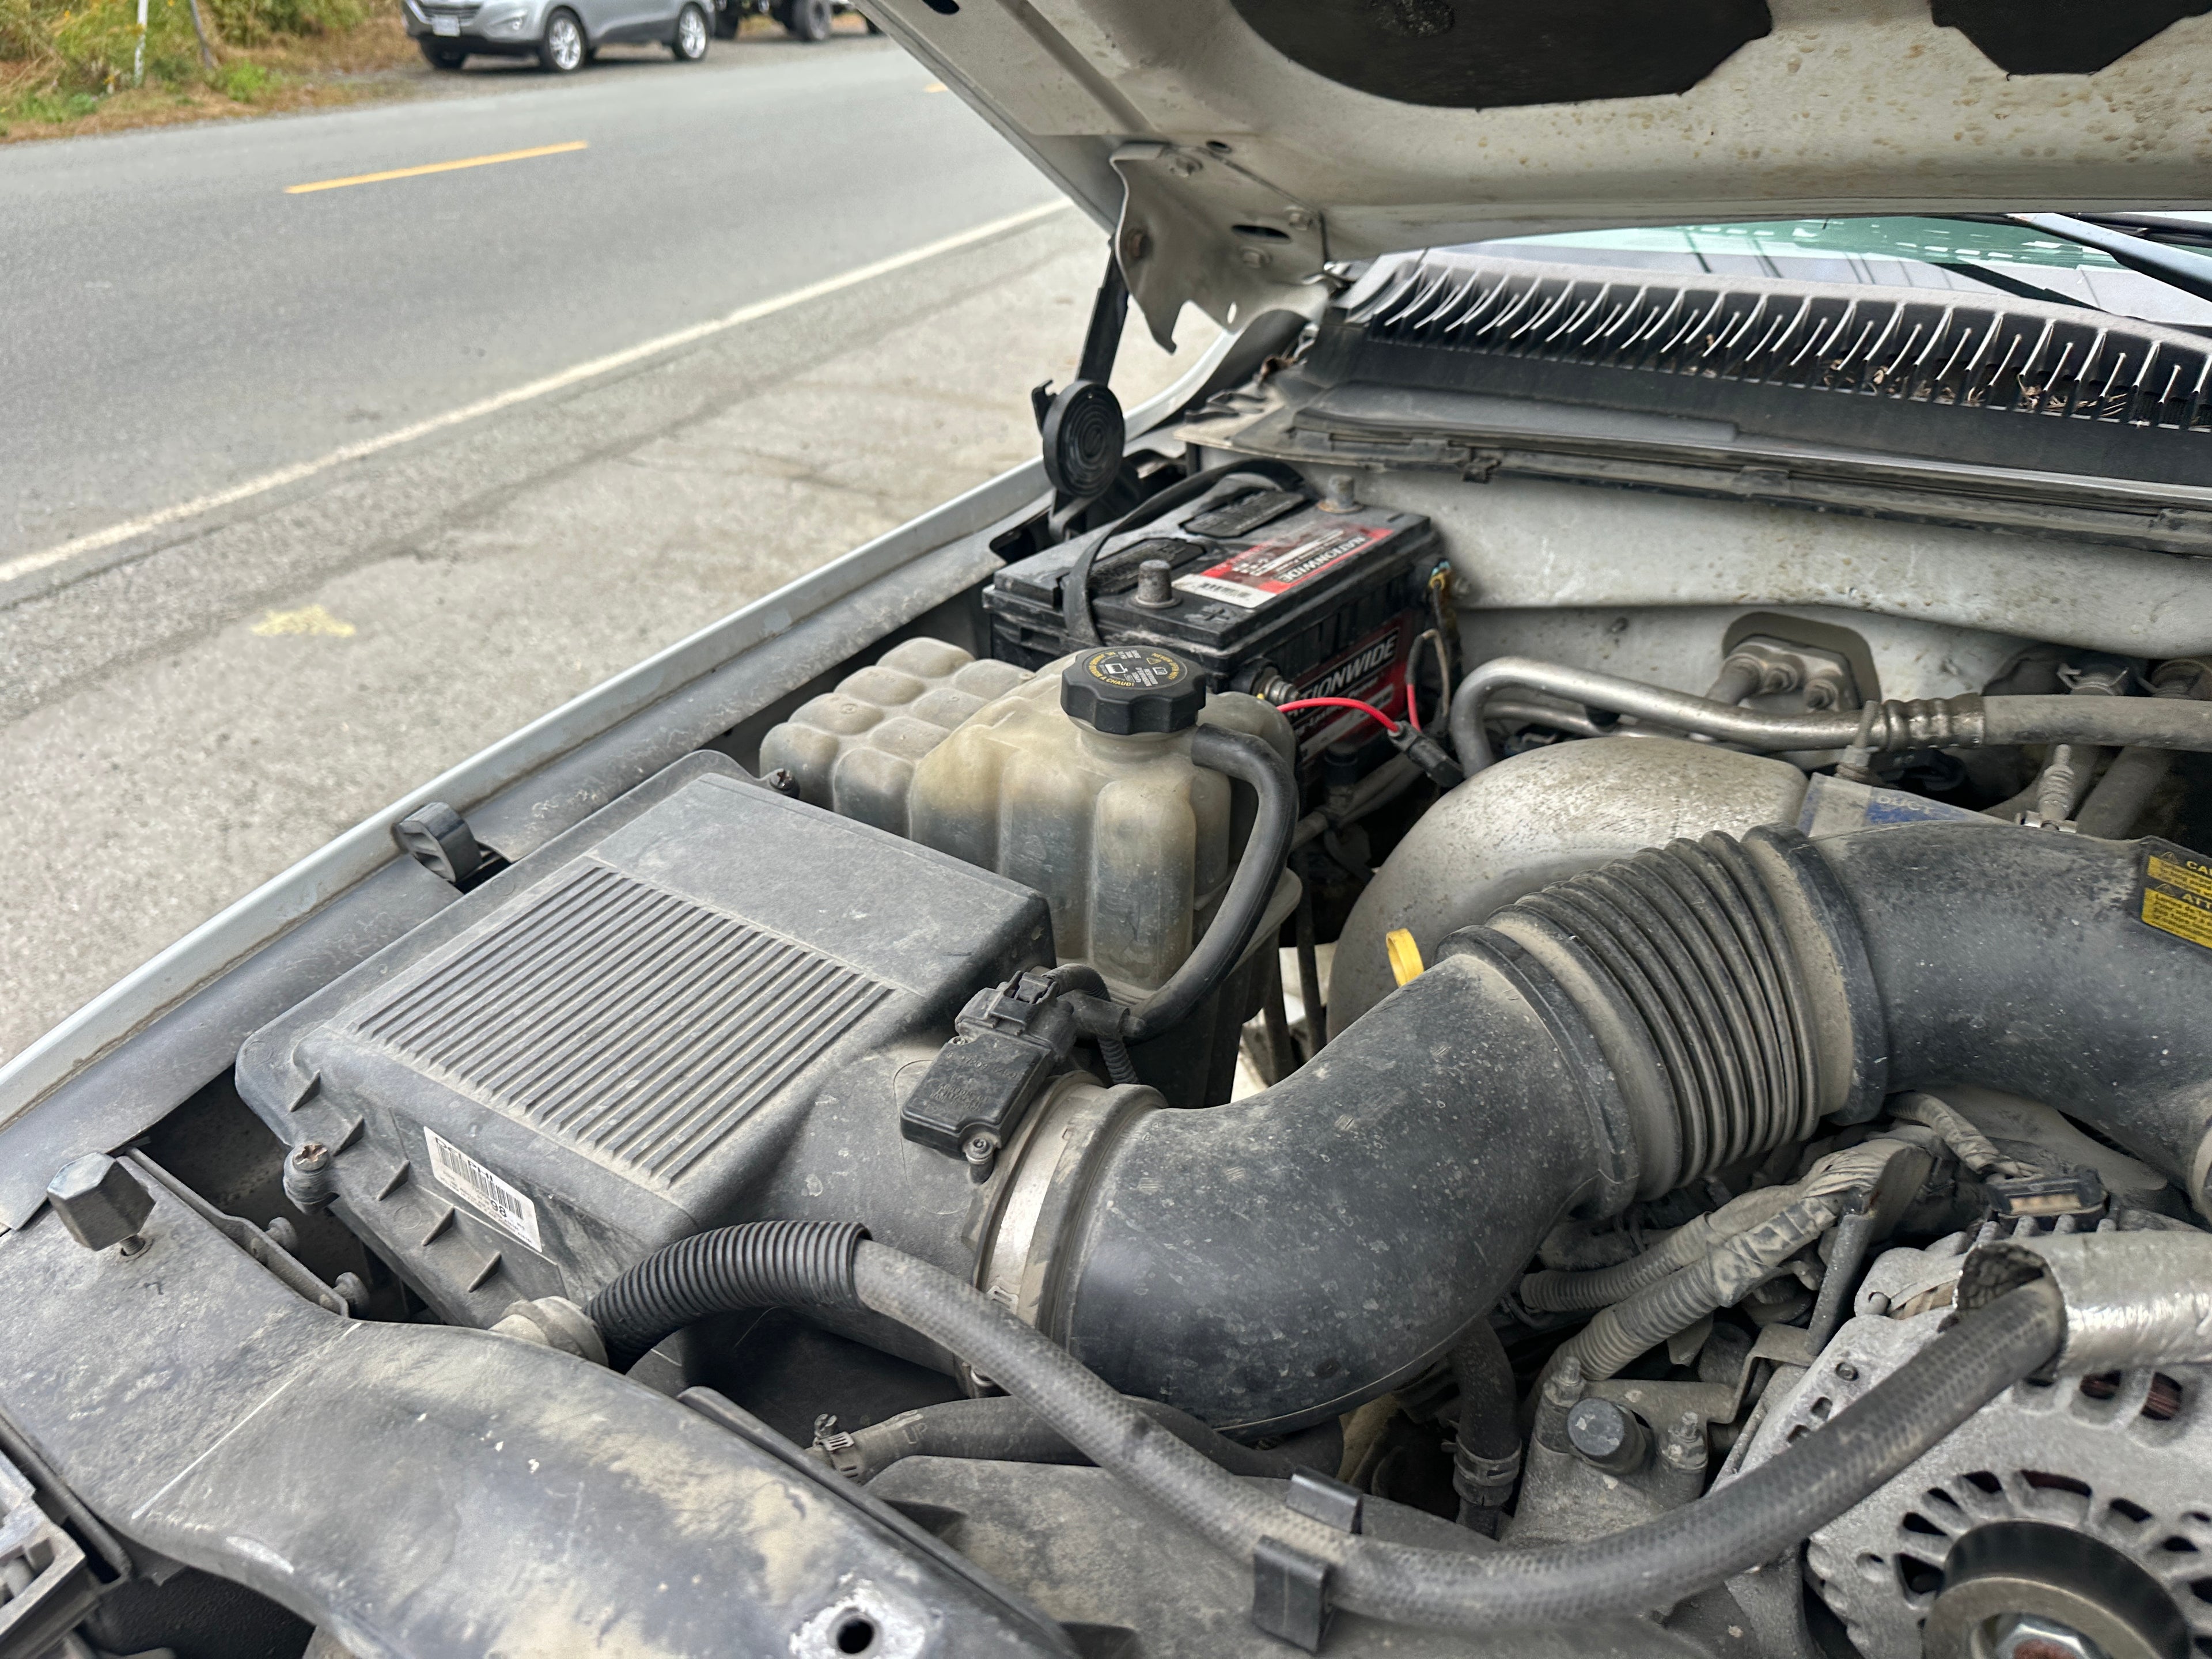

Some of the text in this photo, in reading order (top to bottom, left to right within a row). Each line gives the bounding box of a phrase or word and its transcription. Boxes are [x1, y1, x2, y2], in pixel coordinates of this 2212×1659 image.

[1279, 536, 1366, 582] NATIONWIDE
[1106, 678, 1134, 687] CHAUD!
[1287, 635, 1396, 717] TIONWIDE
[2186, 861, 2212, 876] CA
[435, 1137, 493, 1181] DELPHI
